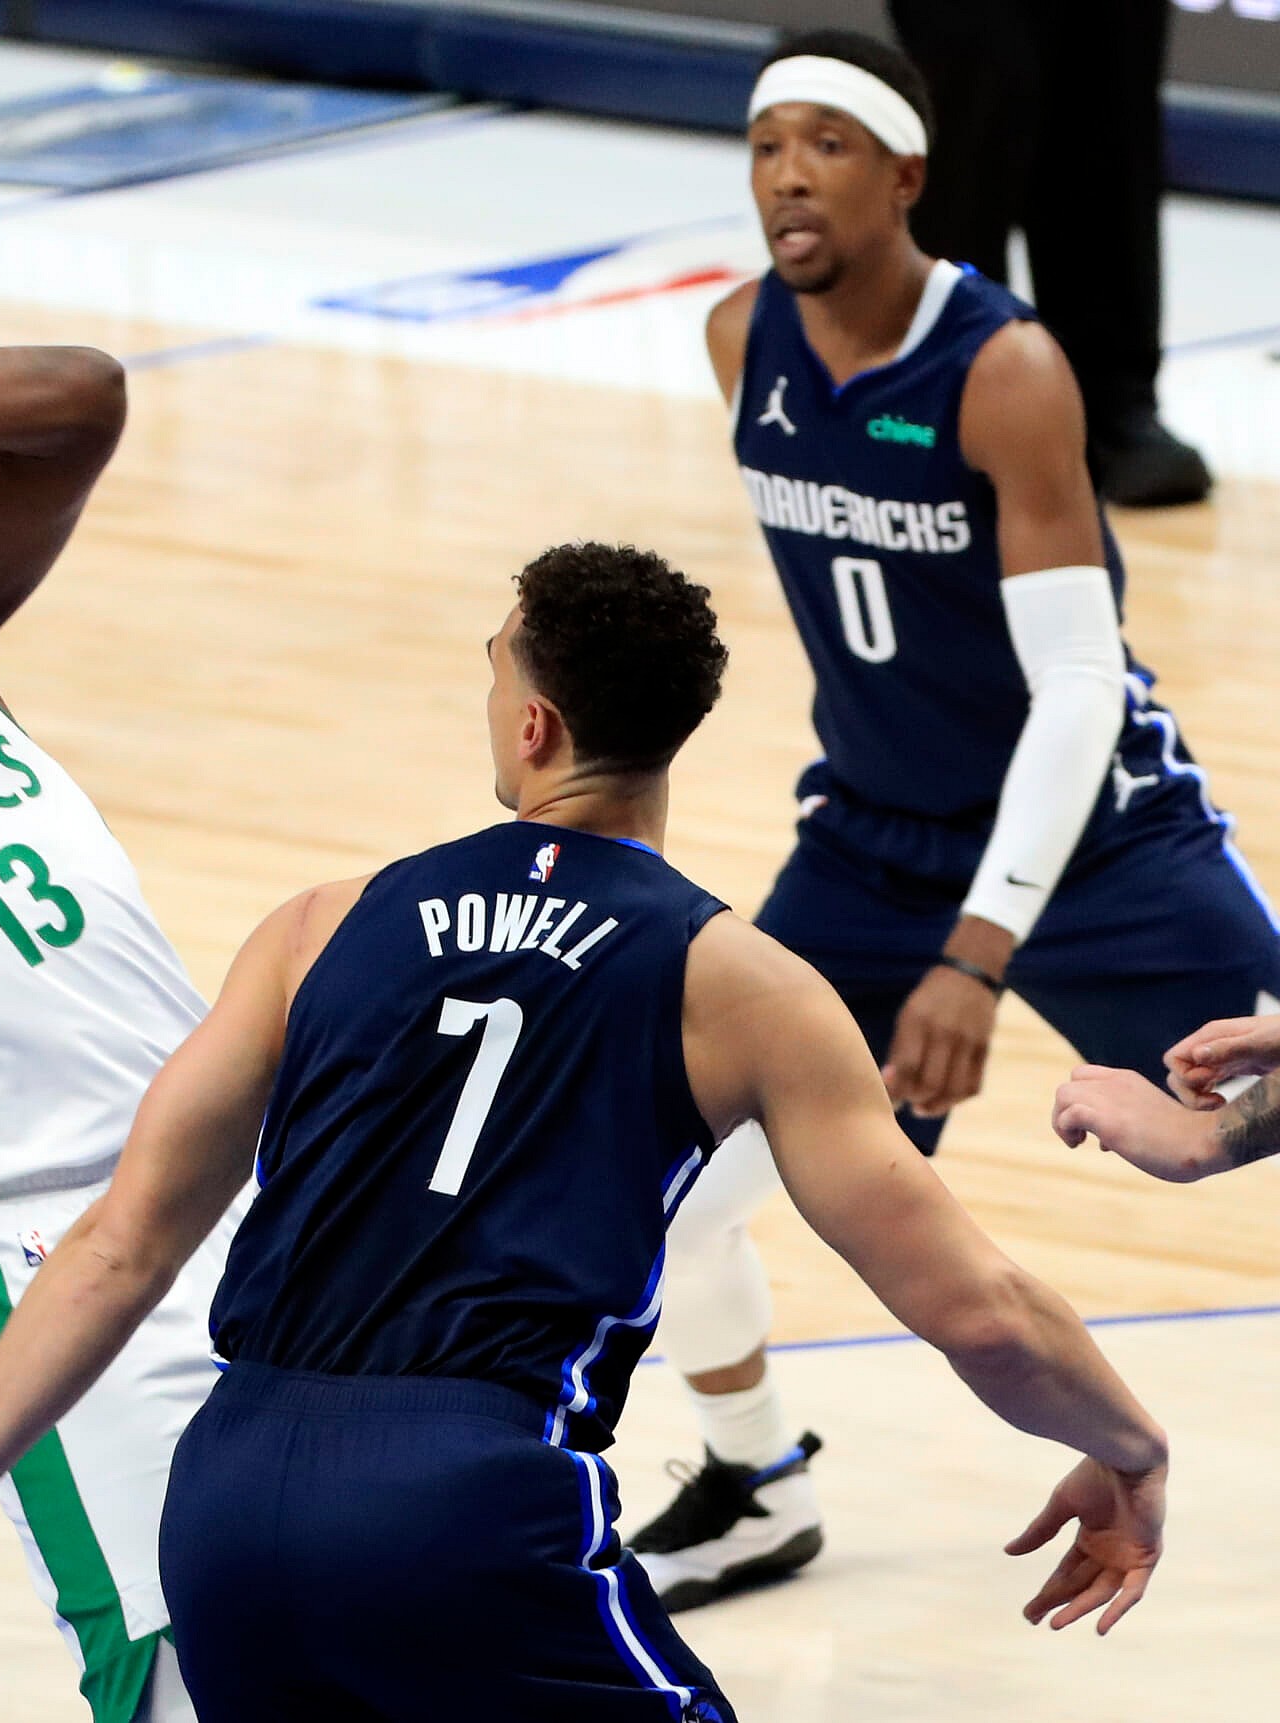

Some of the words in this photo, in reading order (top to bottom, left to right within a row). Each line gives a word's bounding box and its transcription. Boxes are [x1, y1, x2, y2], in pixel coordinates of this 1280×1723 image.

[831, 556, 897, 664] 0
[418, 892, 619, 971] POWELL
[427, 996, 524, 1196] 7
